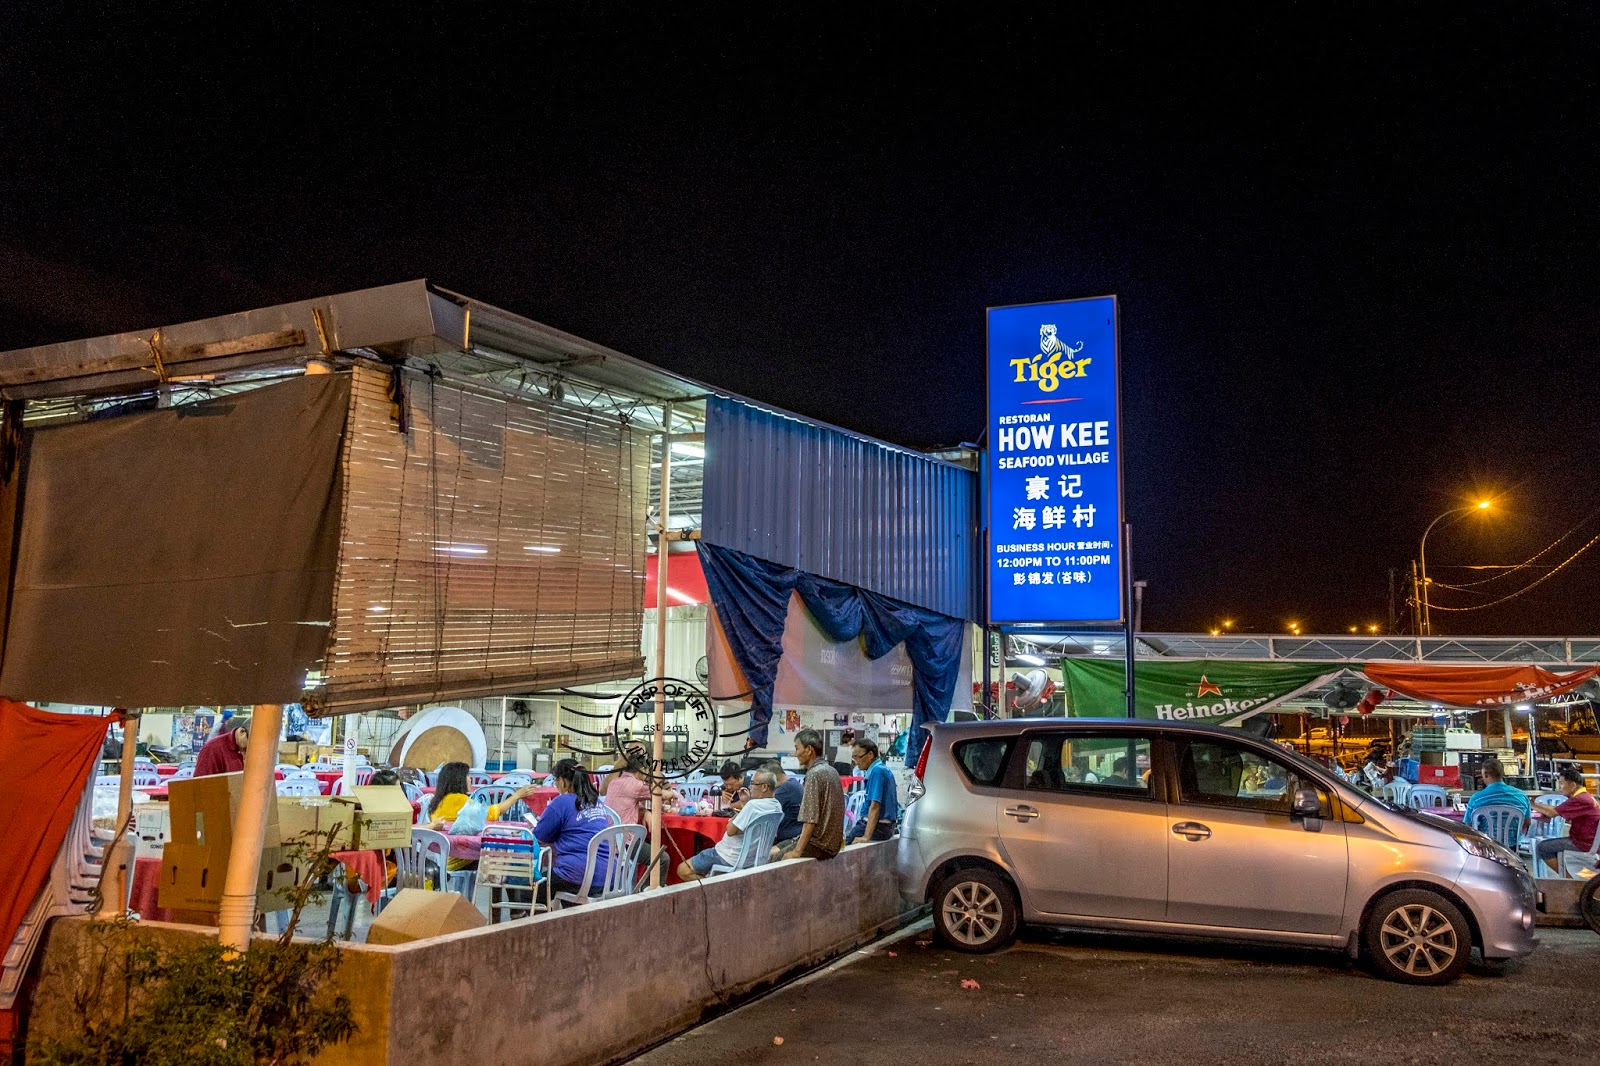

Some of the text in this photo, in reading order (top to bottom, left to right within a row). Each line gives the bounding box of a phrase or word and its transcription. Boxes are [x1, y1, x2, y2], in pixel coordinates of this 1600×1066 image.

[1010, 352, 1092, 392] Tiger
[999, 413, 1051, 425] RESTORAN
[998, 421, 1109, 452] HOW KEE
[998, 452, 1109, 469] SEAFOOD VILLAGE
[1025, 474, 1083, 501] 豪记
[1012, 503, 1097, 531] 海鲜村
[996, 543, 1045, 553] BUSINESS
[1047, 542, 1076, 552] HOUR
[997, 554, 1111, 568] 12:00PM TO 11:00PM
